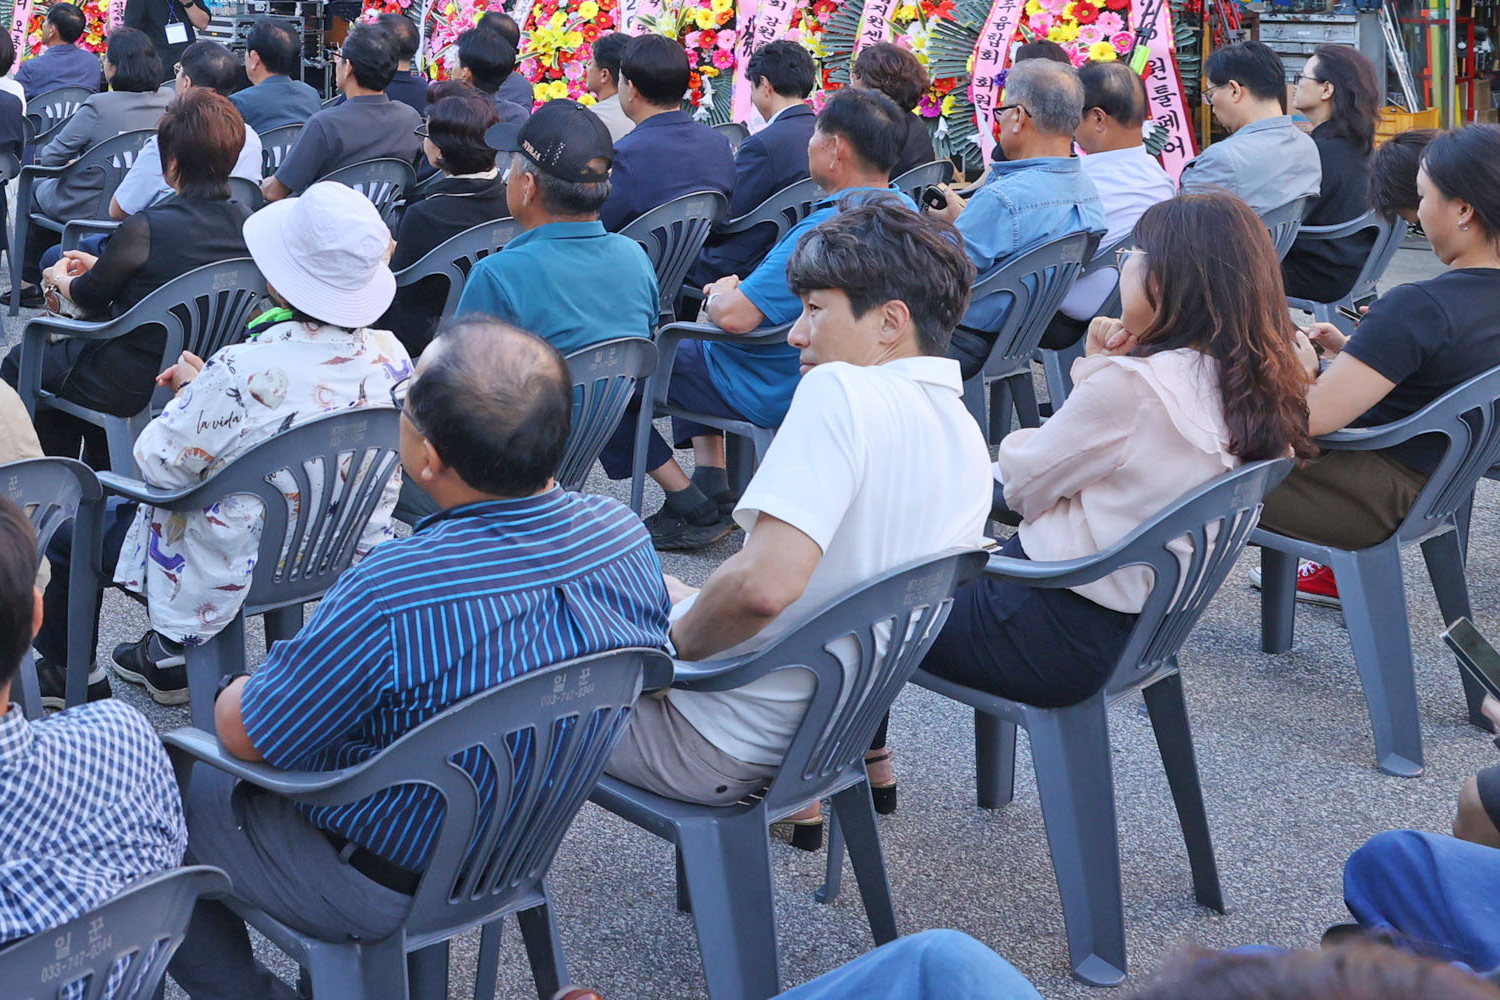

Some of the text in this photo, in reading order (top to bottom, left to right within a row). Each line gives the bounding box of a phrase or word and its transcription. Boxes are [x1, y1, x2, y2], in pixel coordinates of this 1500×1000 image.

[197, 411, 243, 435] la vida
[540, 685, 596, 708] 033-747-0344
[40, 935, 114, 982] 033-747-0344
